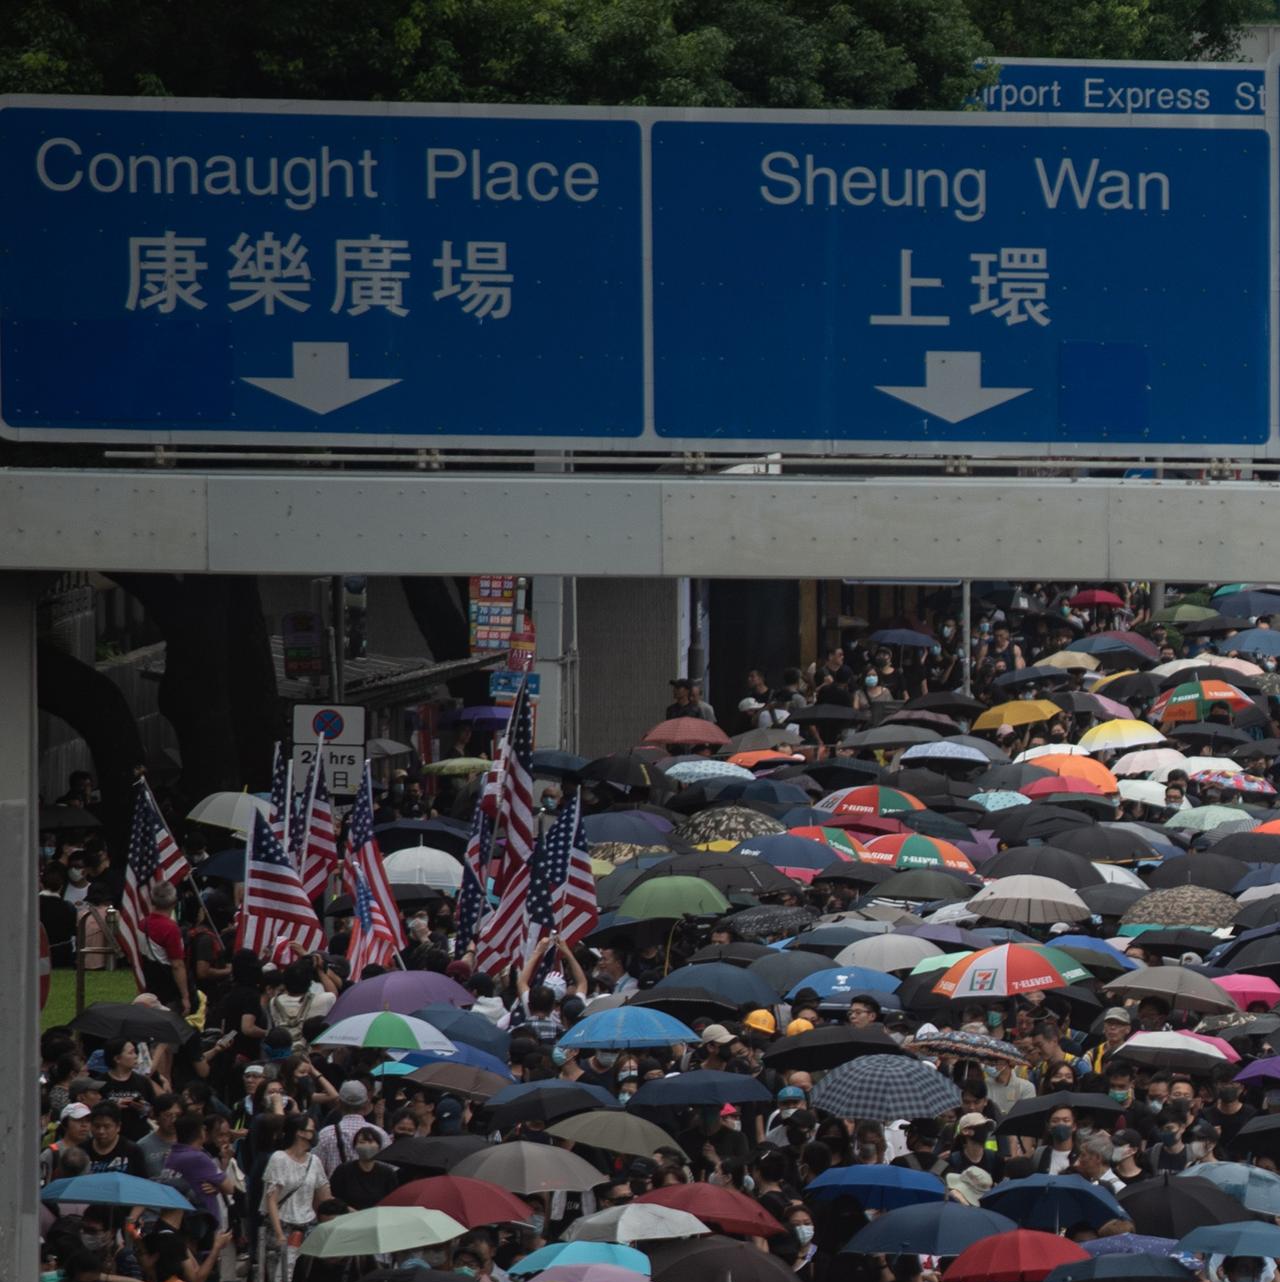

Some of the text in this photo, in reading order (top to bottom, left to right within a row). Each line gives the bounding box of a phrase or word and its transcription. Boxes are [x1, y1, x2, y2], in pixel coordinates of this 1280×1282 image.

[982, 80, 1061, 112] irport
[1084, 78, 1210, 113] Express
[36, 137, 600, 211] Connaught Place
[758, 151, 1170, 223] Sheung Wan
[125, 230, 515, 320] 康樂廣場
[869, 247, 1051, 328] 上環
[329, 752, 356, 766] hrs
